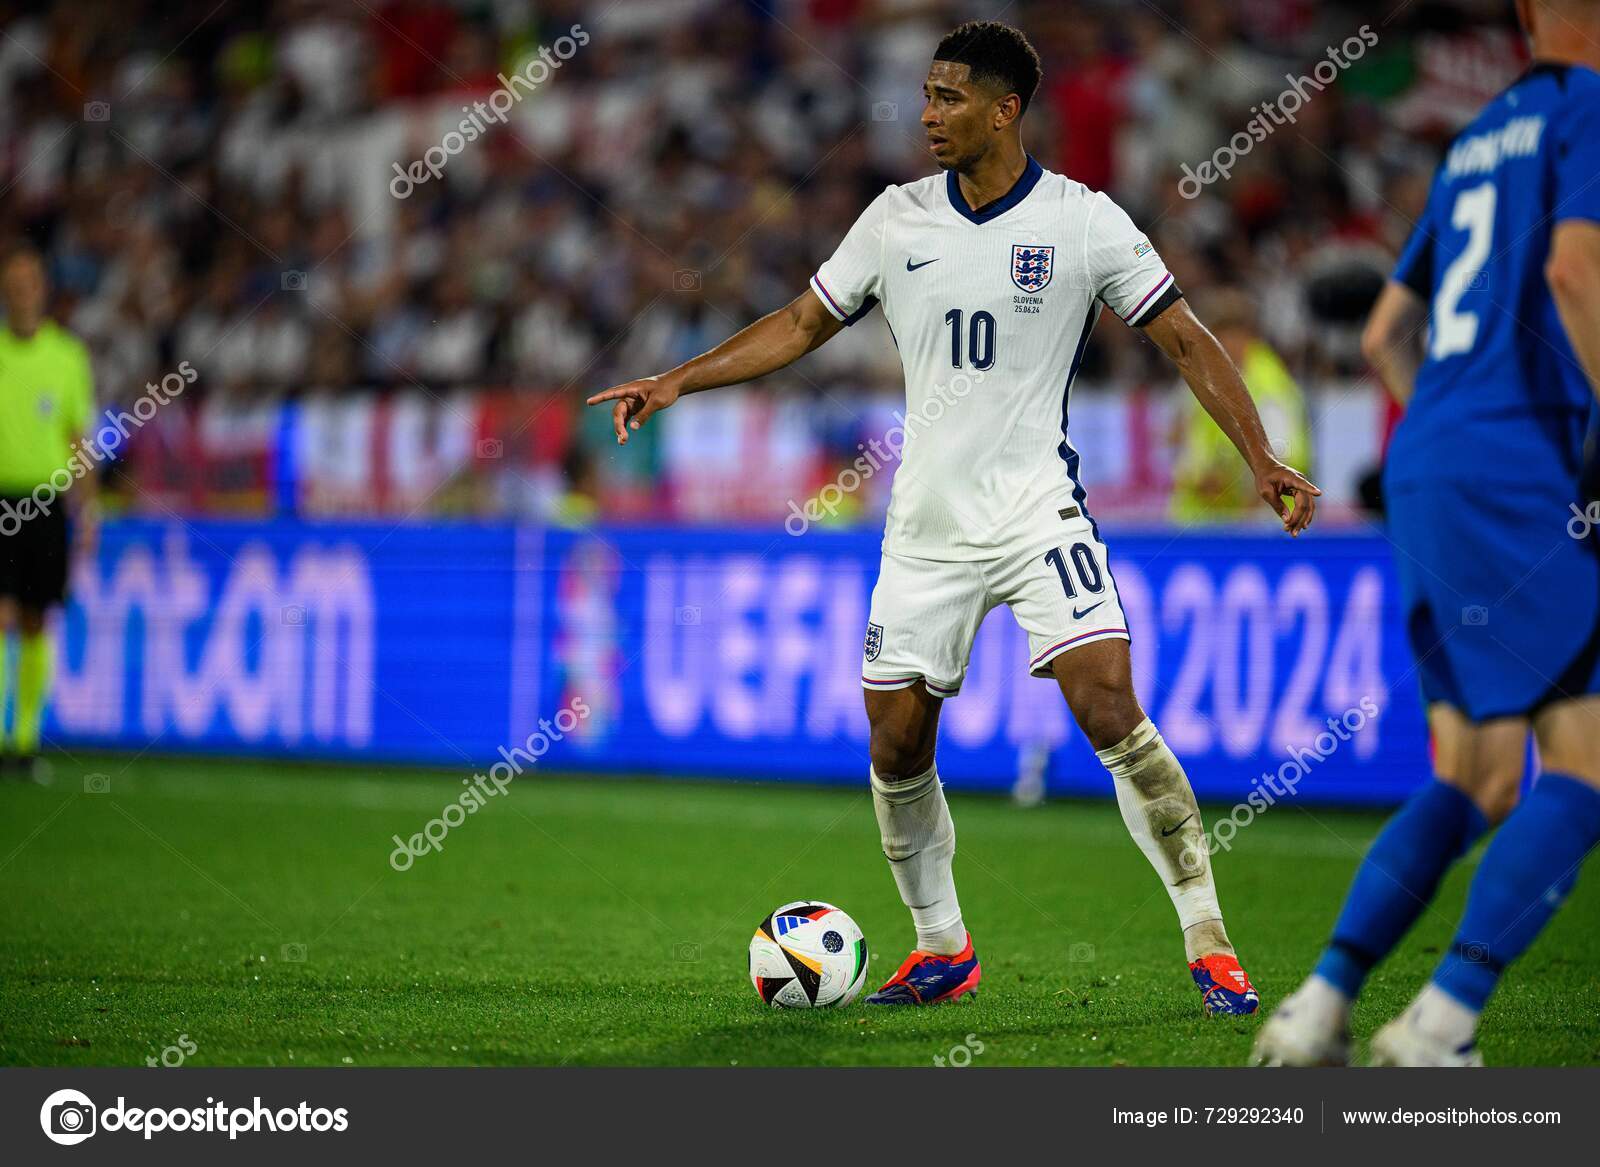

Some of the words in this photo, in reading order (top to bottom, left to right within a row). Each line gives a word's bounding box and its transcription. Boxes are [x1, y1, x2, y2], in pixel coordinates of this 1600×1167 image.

[1013, 295, 1044, 305] SLOVENIA
[1432, 182, 1496, 361] 2
[1014, 305, 1040, 314] 25.06.24
[945, 309, 996, 371] 10
[1044, 542, 1105, 599] 10
[644, 552, 869, 742] UEFA
[1157, 560, 1388, 764] 2024
